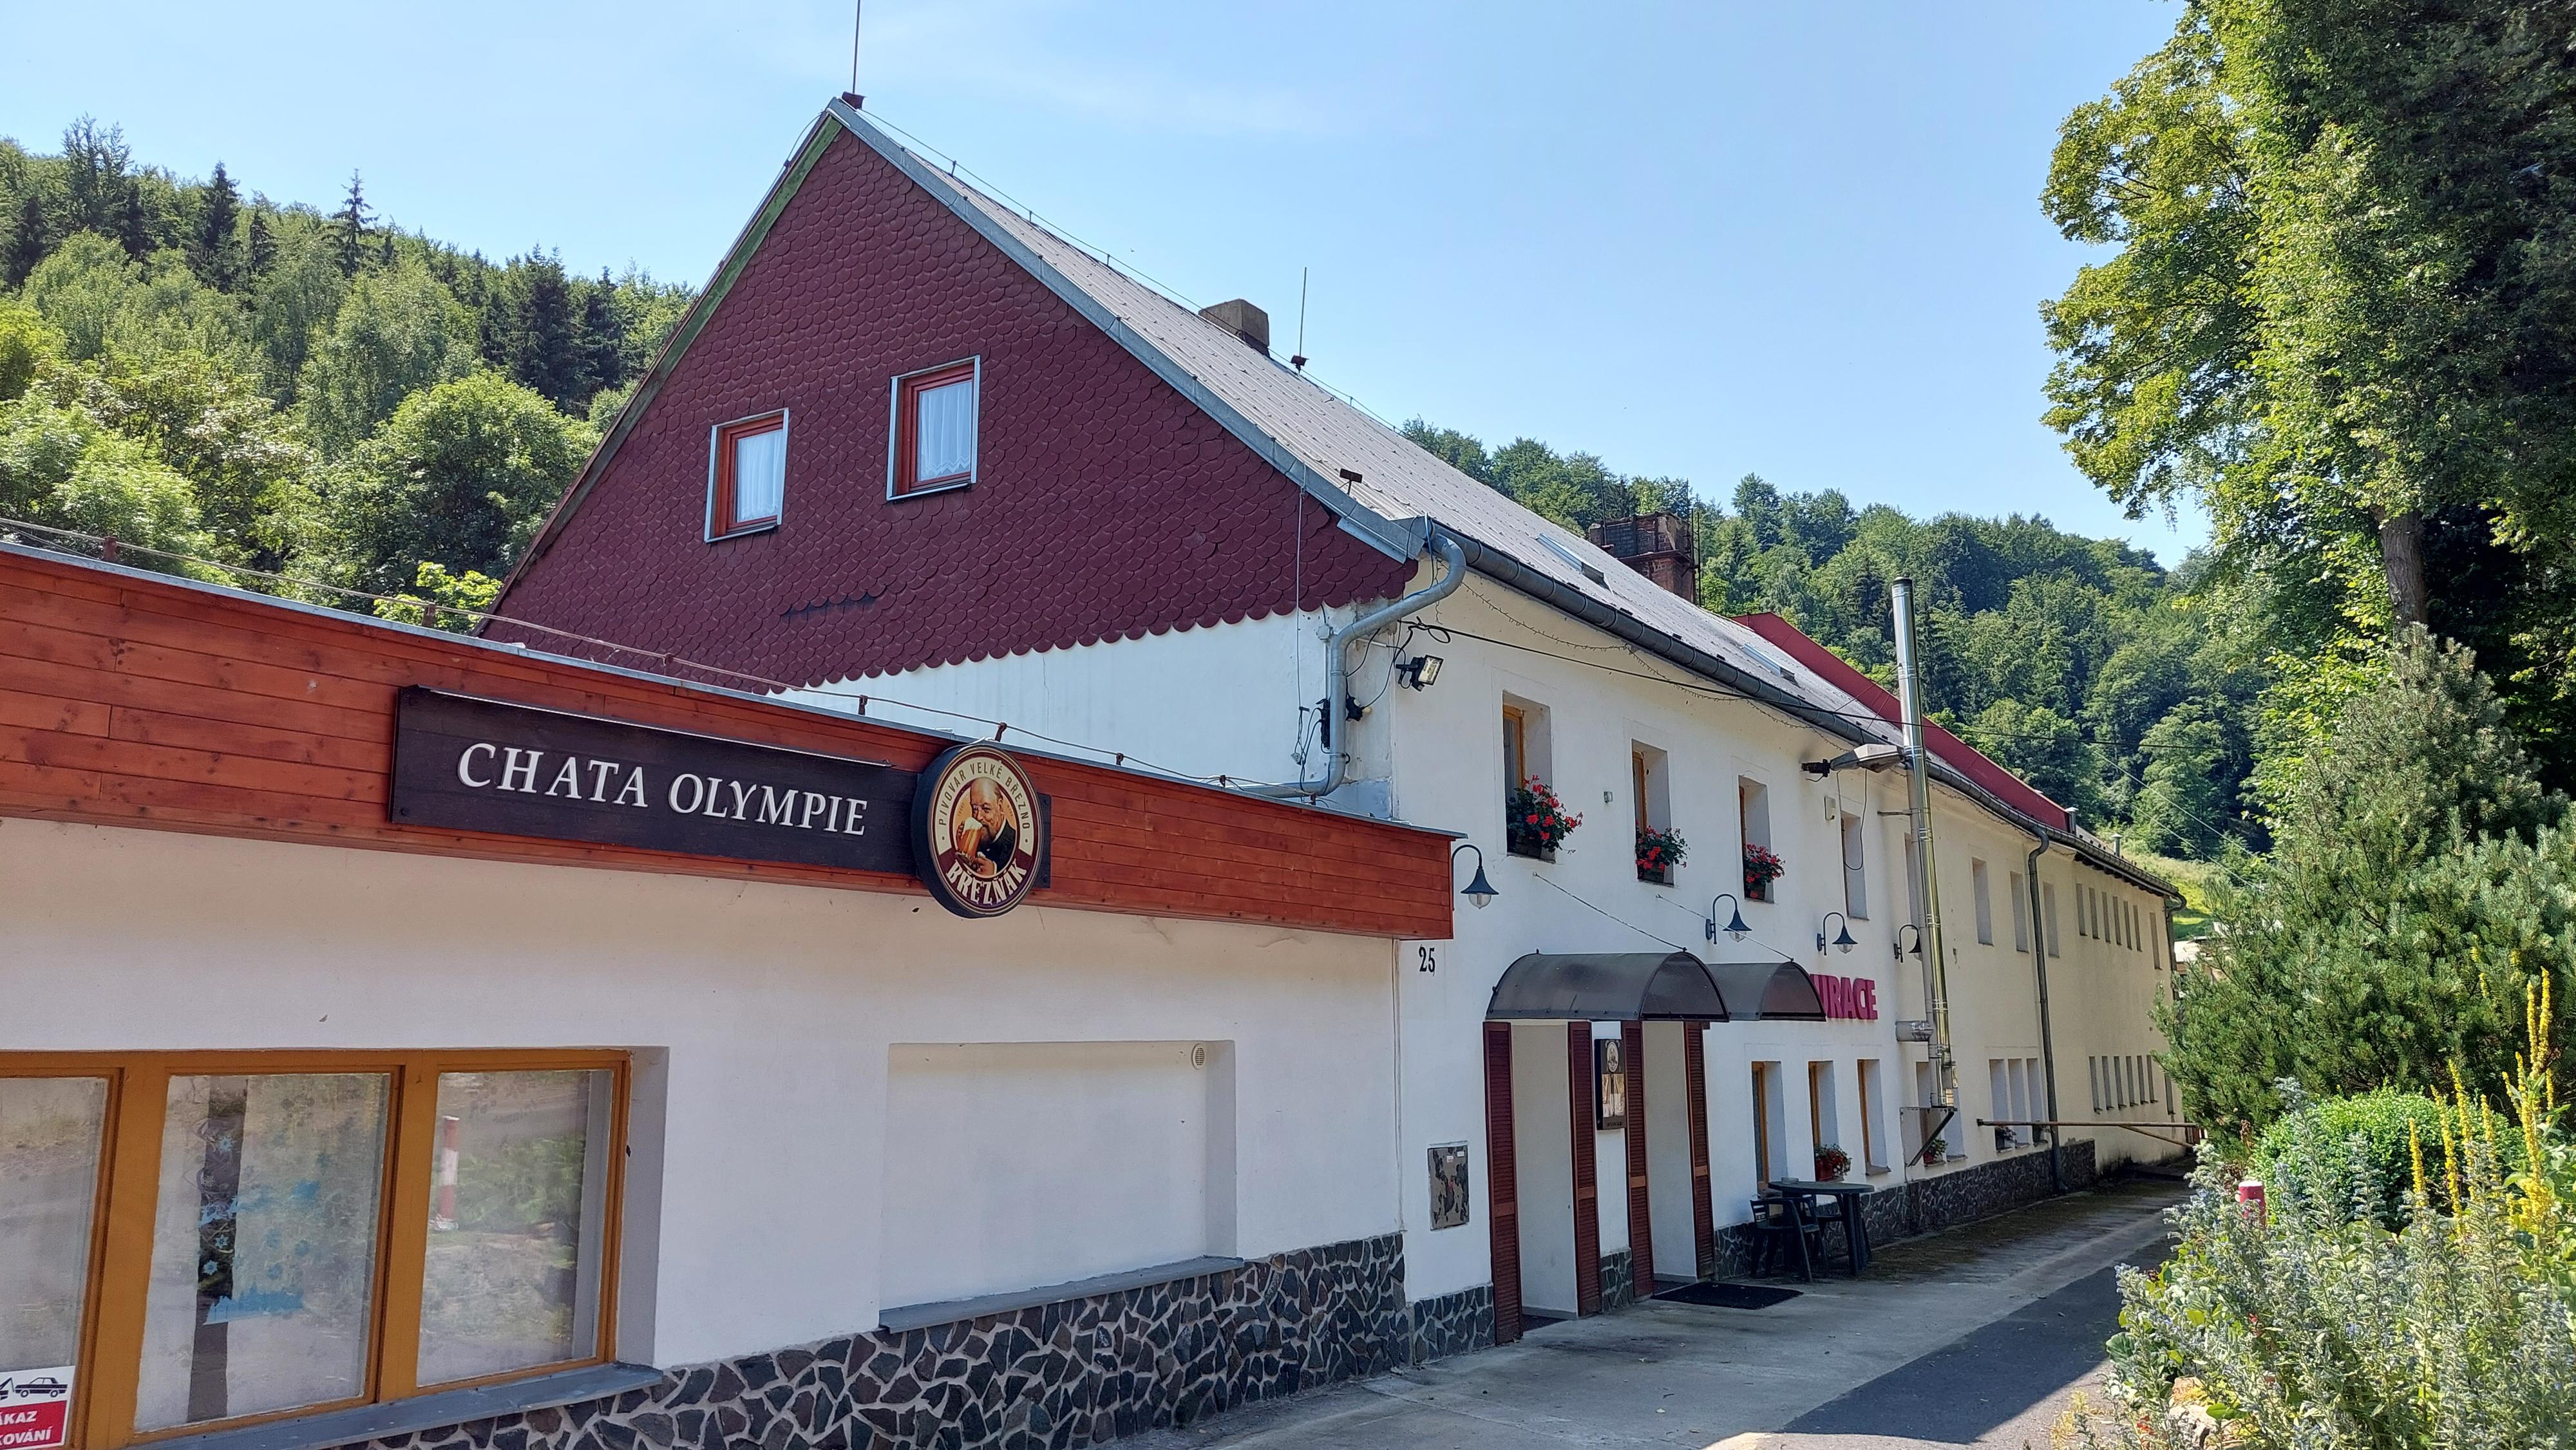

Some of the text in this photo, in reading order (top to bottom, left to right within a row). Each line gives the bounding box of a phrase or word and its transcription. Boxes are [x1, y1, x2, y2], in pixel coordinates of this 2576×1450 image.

[457, 742, 868, 836] CHATA OLYMPIE
[938, 762, 1030, 829] PIVOVAR VELKÉ BŘEZNO
[945, 859, 1027, 905] BŘEZŇÁK
[1419, 944, 1435, 977] 25
[0, 1411, 37, 1426] KAZ
[0, 1426, 53, 1446] OVÁNÍ
